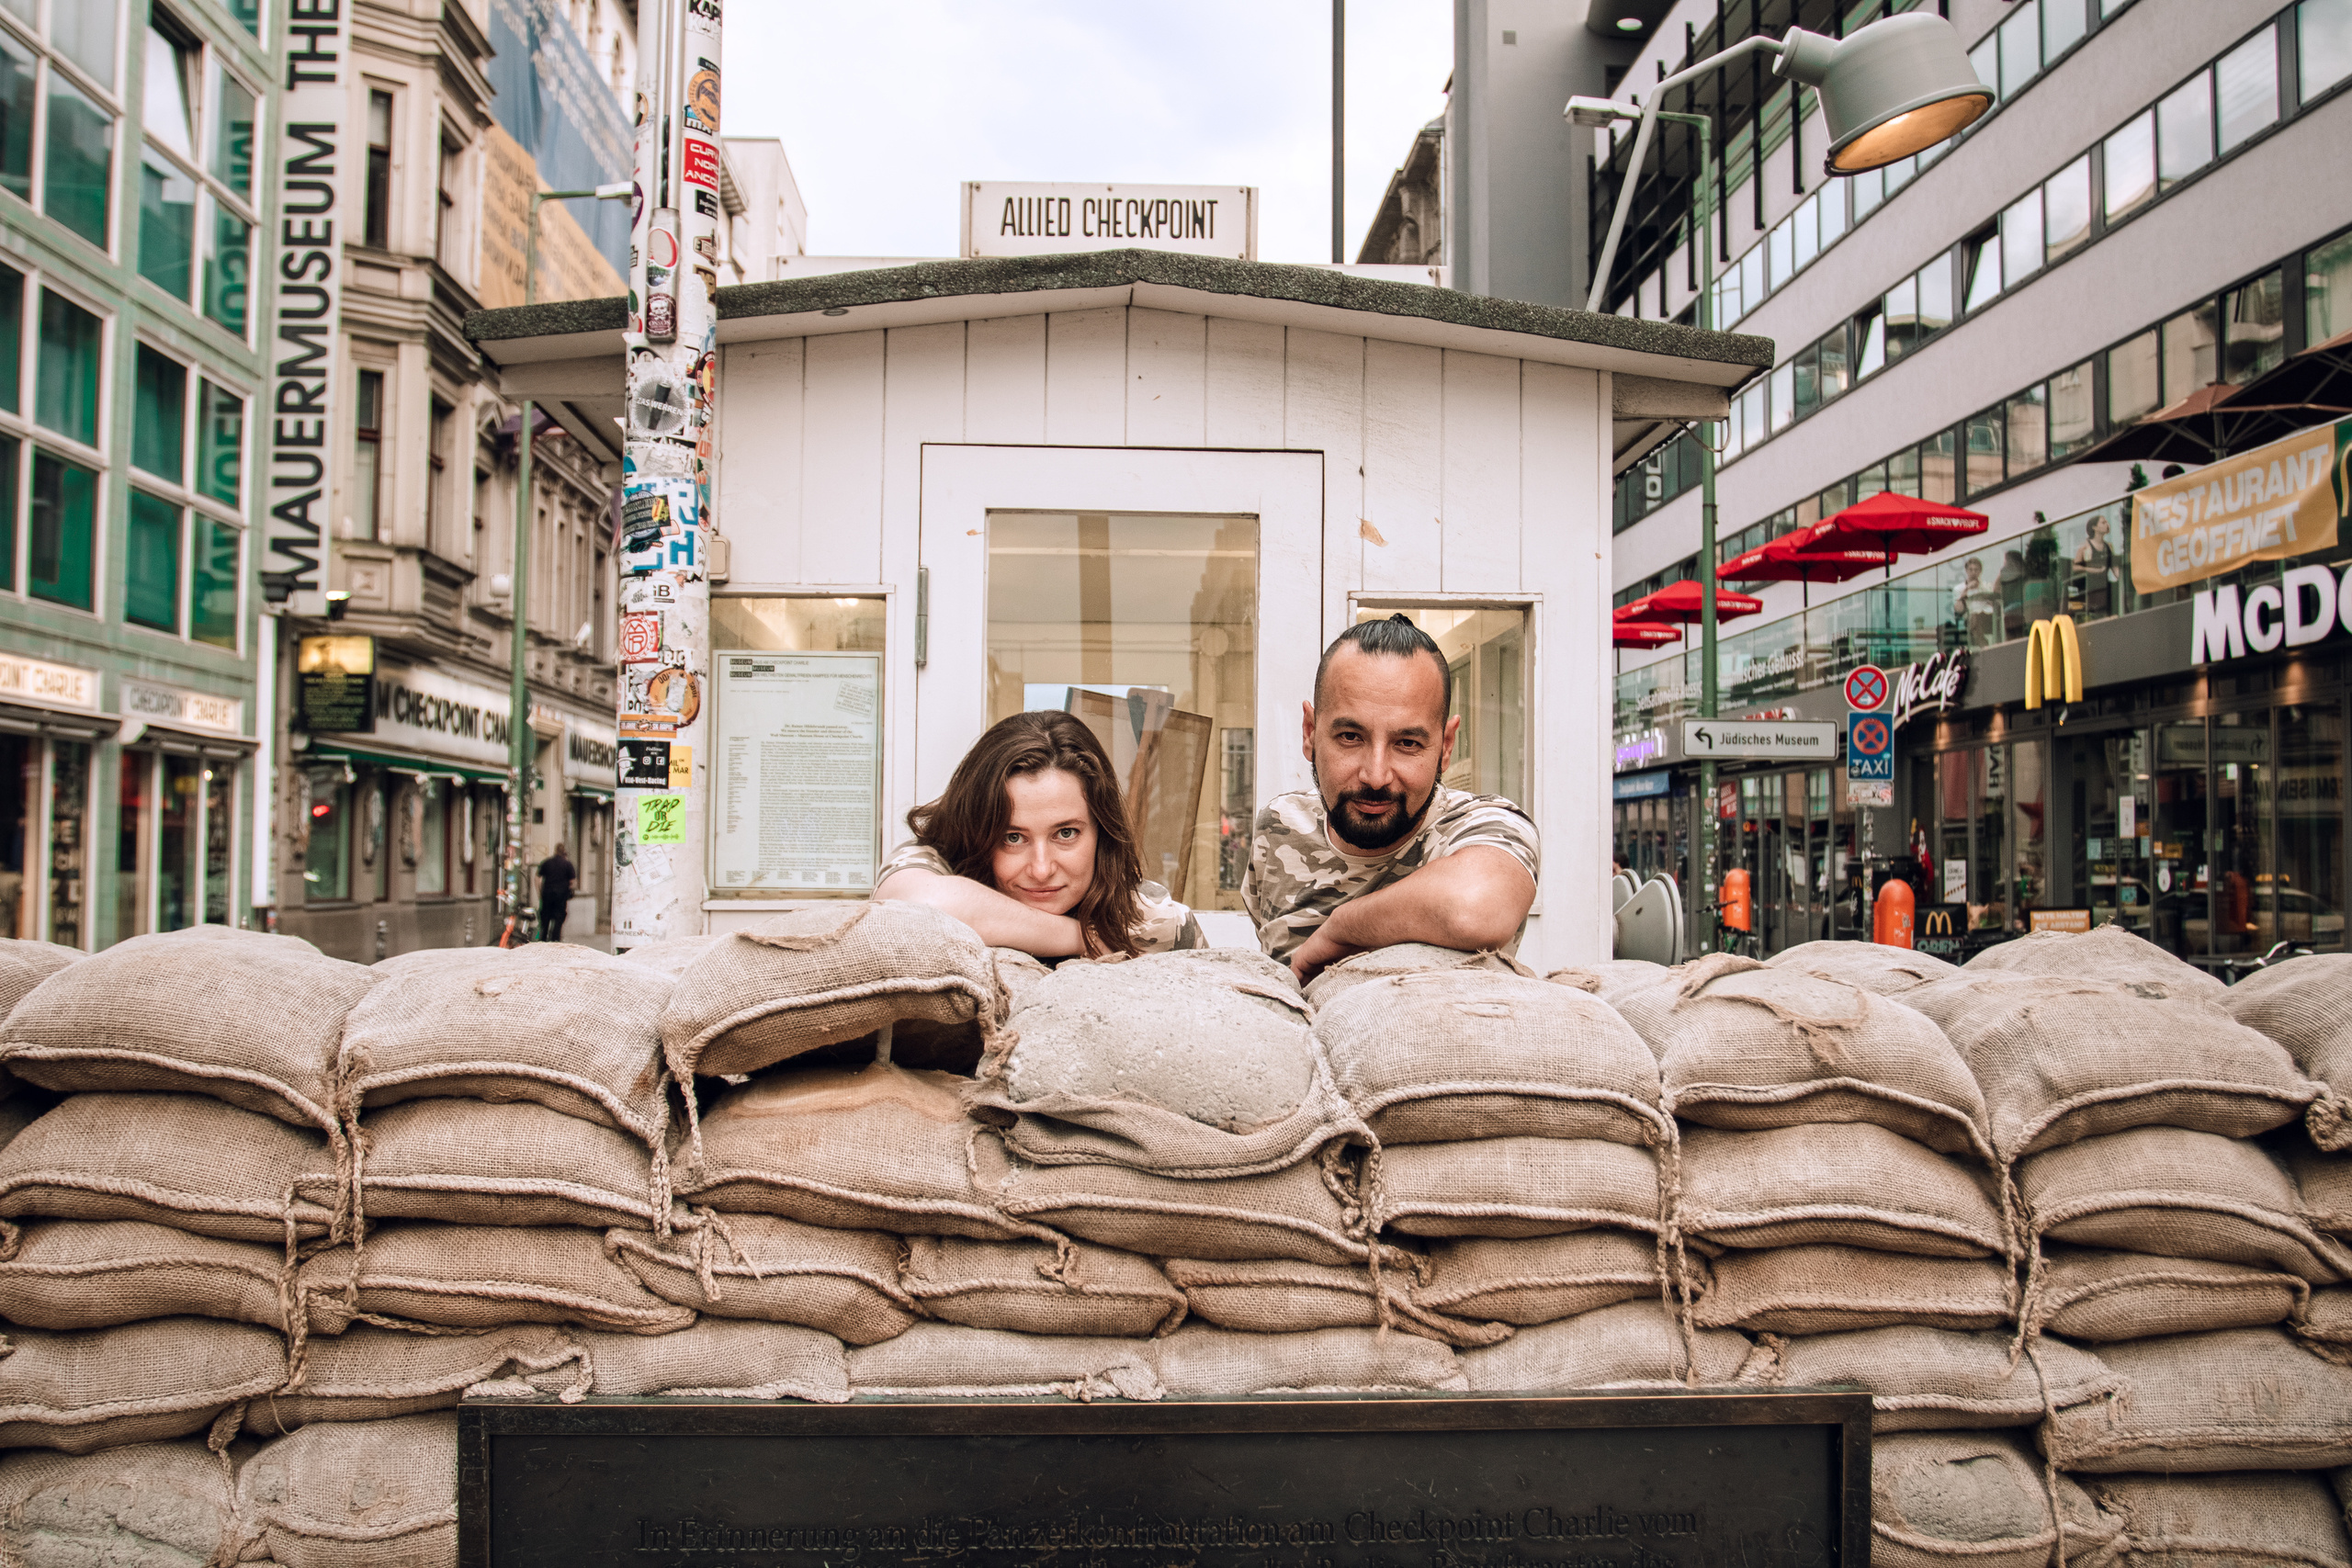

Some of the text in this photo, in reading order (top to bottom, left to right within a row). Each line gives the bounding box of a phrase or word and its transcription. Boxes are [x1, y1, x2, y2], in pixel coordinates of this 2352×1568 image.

[1001, 196, 1218, 240] ALLIED CHECKPOINT
[271, 123, 339, 592] MAUERMUSEUM
[2138, 444, 2328, 540] RESTAURANT
[2156, 501, 2300, 578] GEÖFFNET
[33, 668, 85, 702] CHARLIE
[130, 685, 228, 726] CHECKPOINT CHARLIE
[1894, 648, 1963, 723] McCafé
[393, 684, 480, 739] CHECKPOINT
[1720, 732, 1819, 746] Jüdisches Museum
[1852, 759, 1889, 775] TAXI
[642, 798, 681, 813] TRAP
[645, 820, 677, 832] DIE
[653, 810, 668, 821] OR
[636, 1518, 671, 1551] In
[677, 1518, 860, 1562] Erinnerung
[867, 1526, 907, 1551] an
[914, 1517, 961, 1551] die
[967, 1516, 1281, 1550] Panzerkonfrontation
[1288, 1520, 1337, 1546] am
[1342, 1508, 1516, 1552] Checkpoint
[1522, 1506, 1631, 1540] Charlie
[1635, 1510, 1699, 1538] vom
